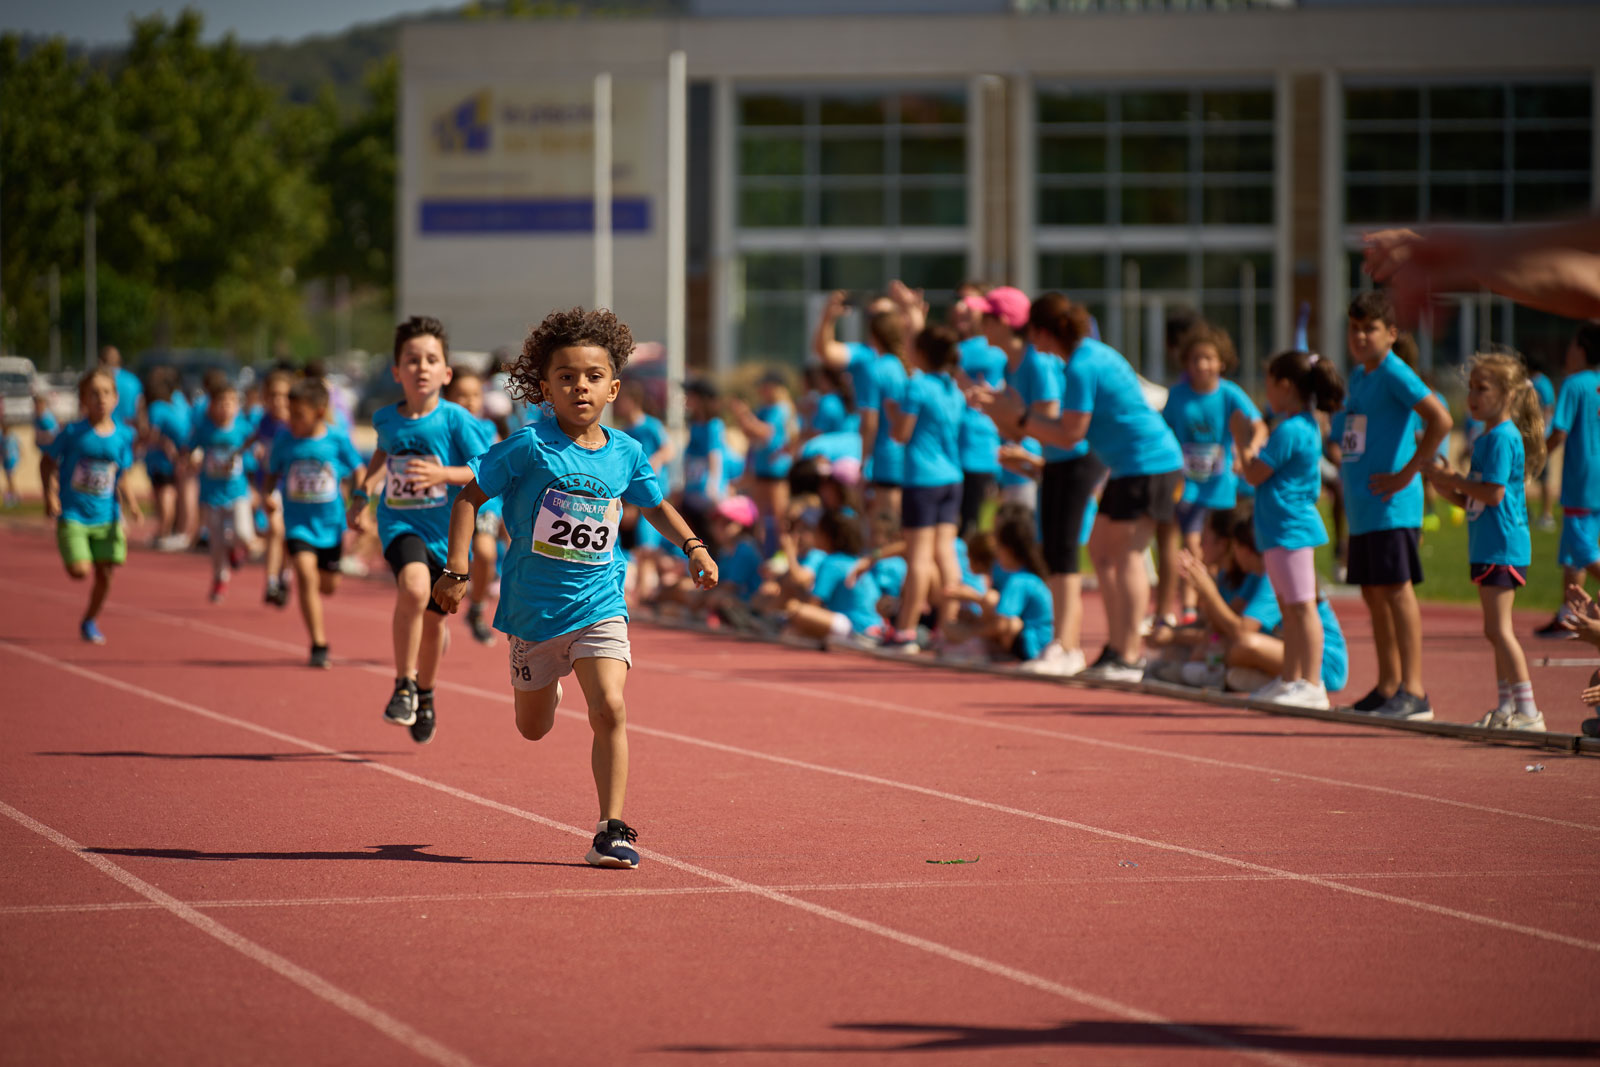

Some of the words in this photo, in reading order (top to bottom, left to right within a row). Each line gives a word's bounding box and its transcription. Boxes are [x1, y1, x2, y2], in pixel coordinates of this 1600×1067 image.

[553, 497, 571, 510] ERICK
[573, 502, 597, 514] CORREA
[548, 520, 609, 551] 263
